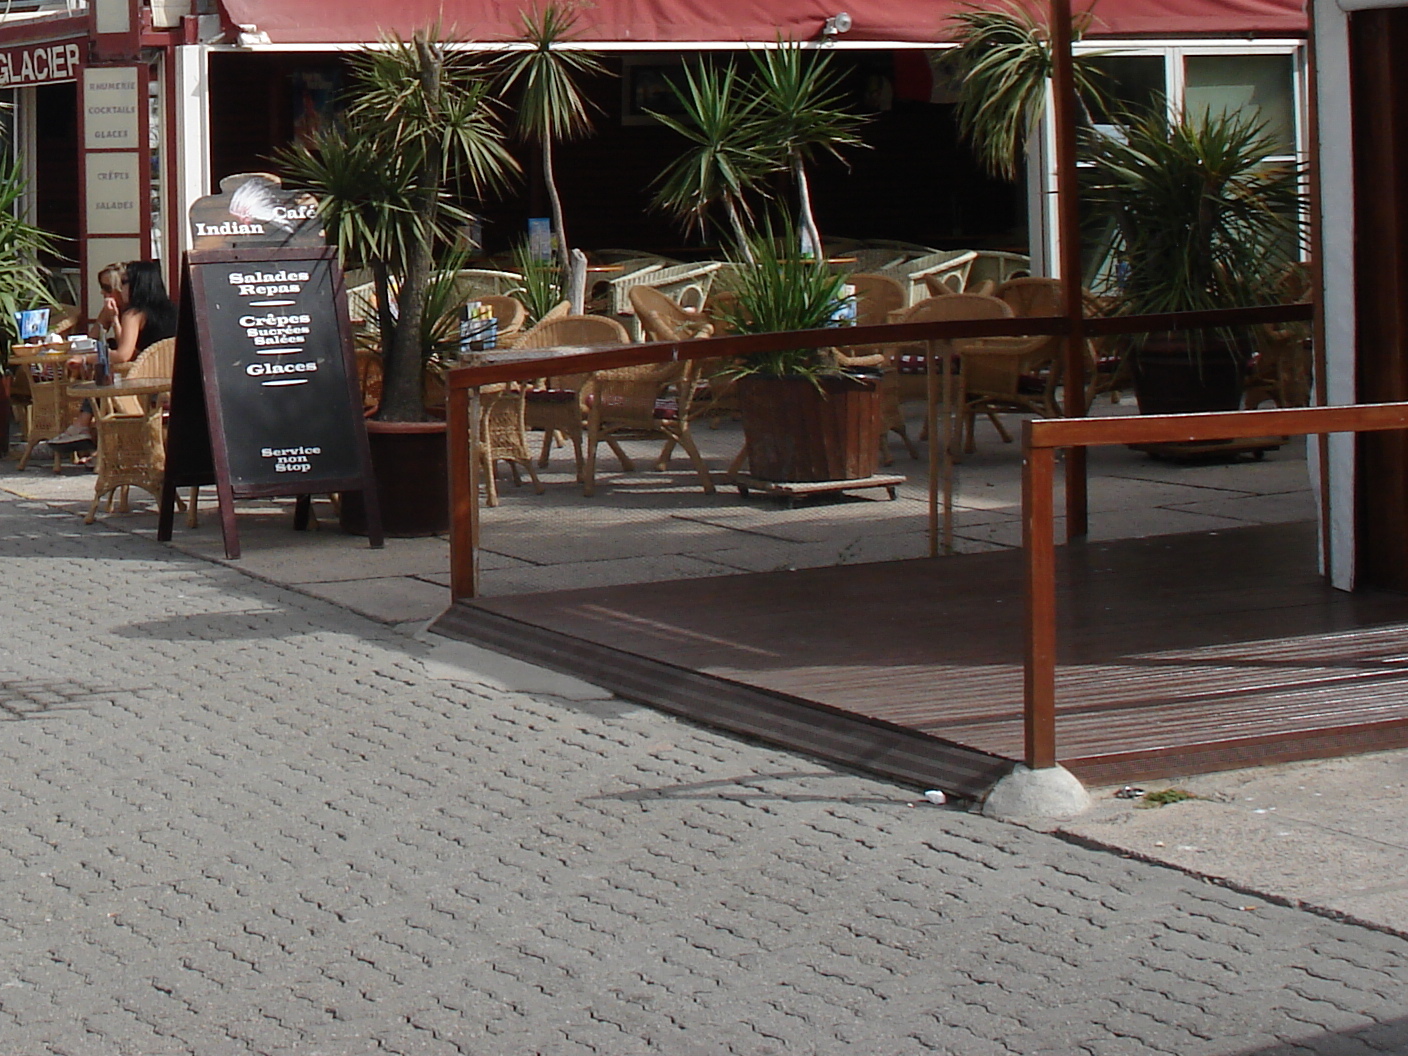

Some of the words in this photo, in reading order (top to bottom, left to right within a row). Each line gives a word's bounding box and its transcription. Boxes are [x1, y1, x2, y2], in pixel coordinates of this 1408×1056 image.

[89, 81, 136, 91] RHUMERIE
[88, 106, 136, 114] COCKTAILS
[94, 130, 128, 139] GLACES
[95, 201, 134, 210] SALADES
[195, 222, 265, 236] Indian
[273, 204, 318, 219] Café
[228, 270, 310, 285] Salades
[238, 284, 301, 297] Repas
[239, 313, 311, 328] Crêpes
[246, 325, 310, 338] Sucrées
[253, 334, 306, 346] Salées
[246, 362, 318, 376] Glaces
[261, 446, 321, 457] Service
[277, 455, 308, 464] non
[275, 463, 311, 473] Stop
